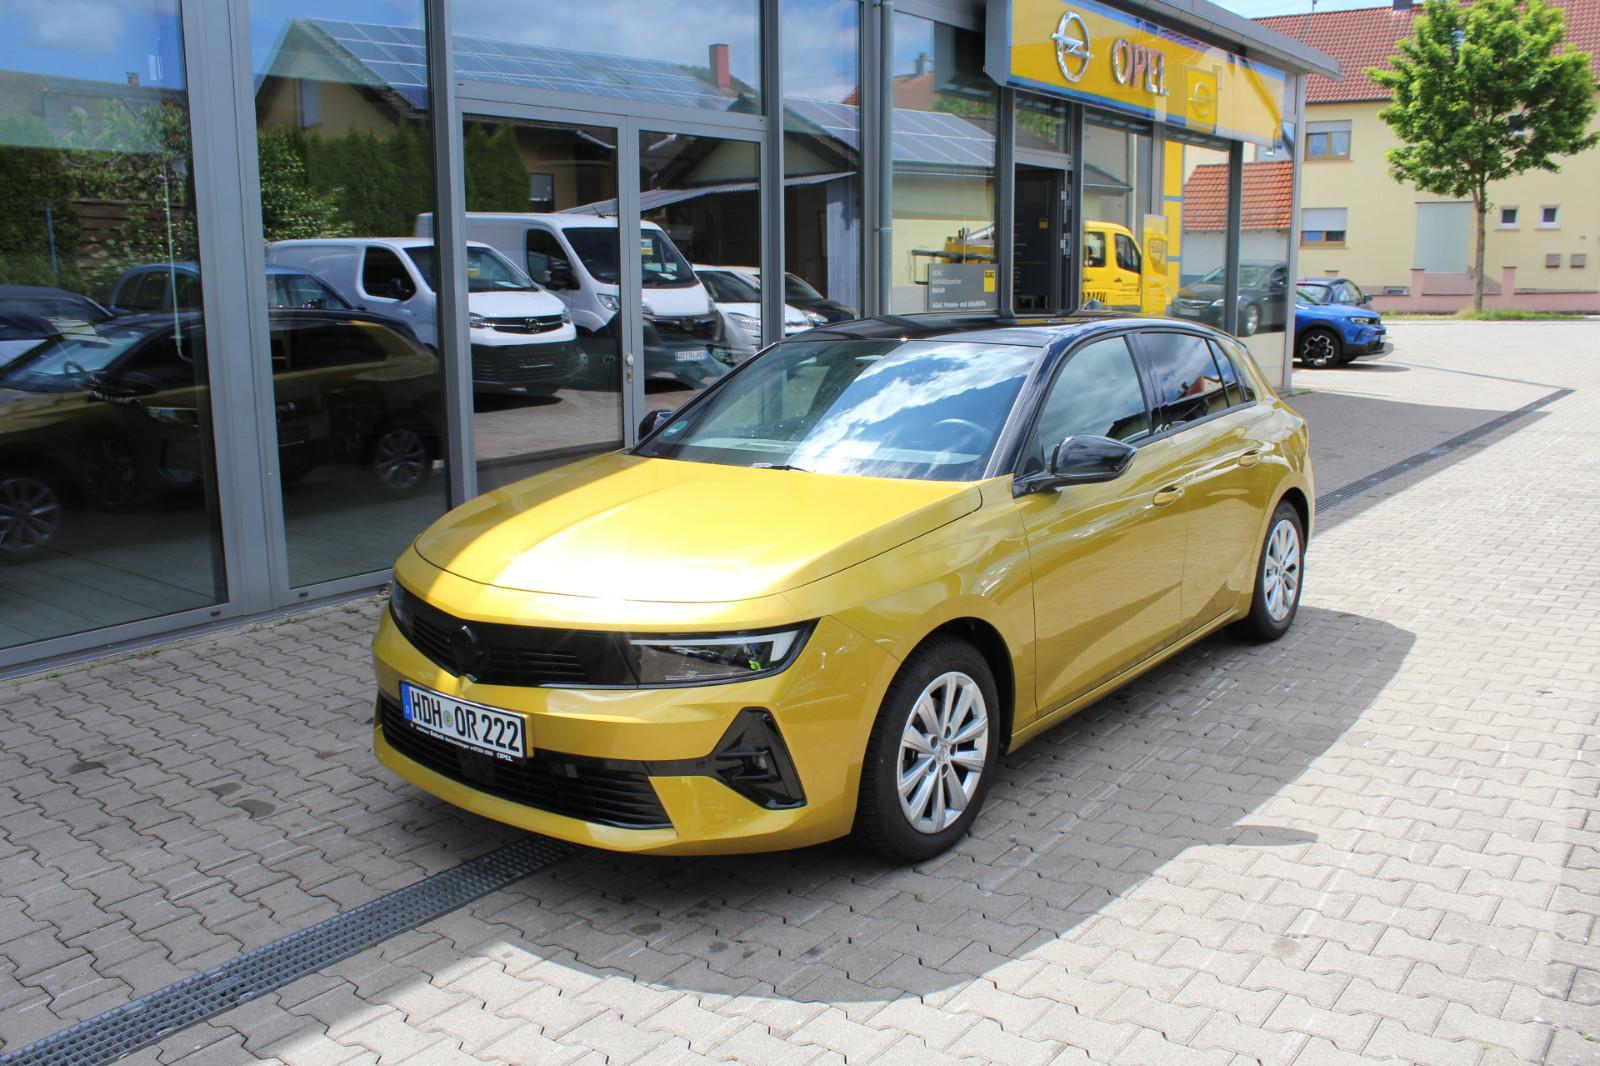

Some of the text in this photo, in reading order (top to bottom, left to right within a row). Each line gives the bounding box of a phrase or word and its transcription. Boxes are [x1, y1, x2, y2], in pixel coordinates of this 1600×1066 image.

[1111, 38, 1168, 96] OPEL
[411, 691, 443, 728] HDH
[454, 706, 479, 741] OR
[481, 713, 520, 752] 222
